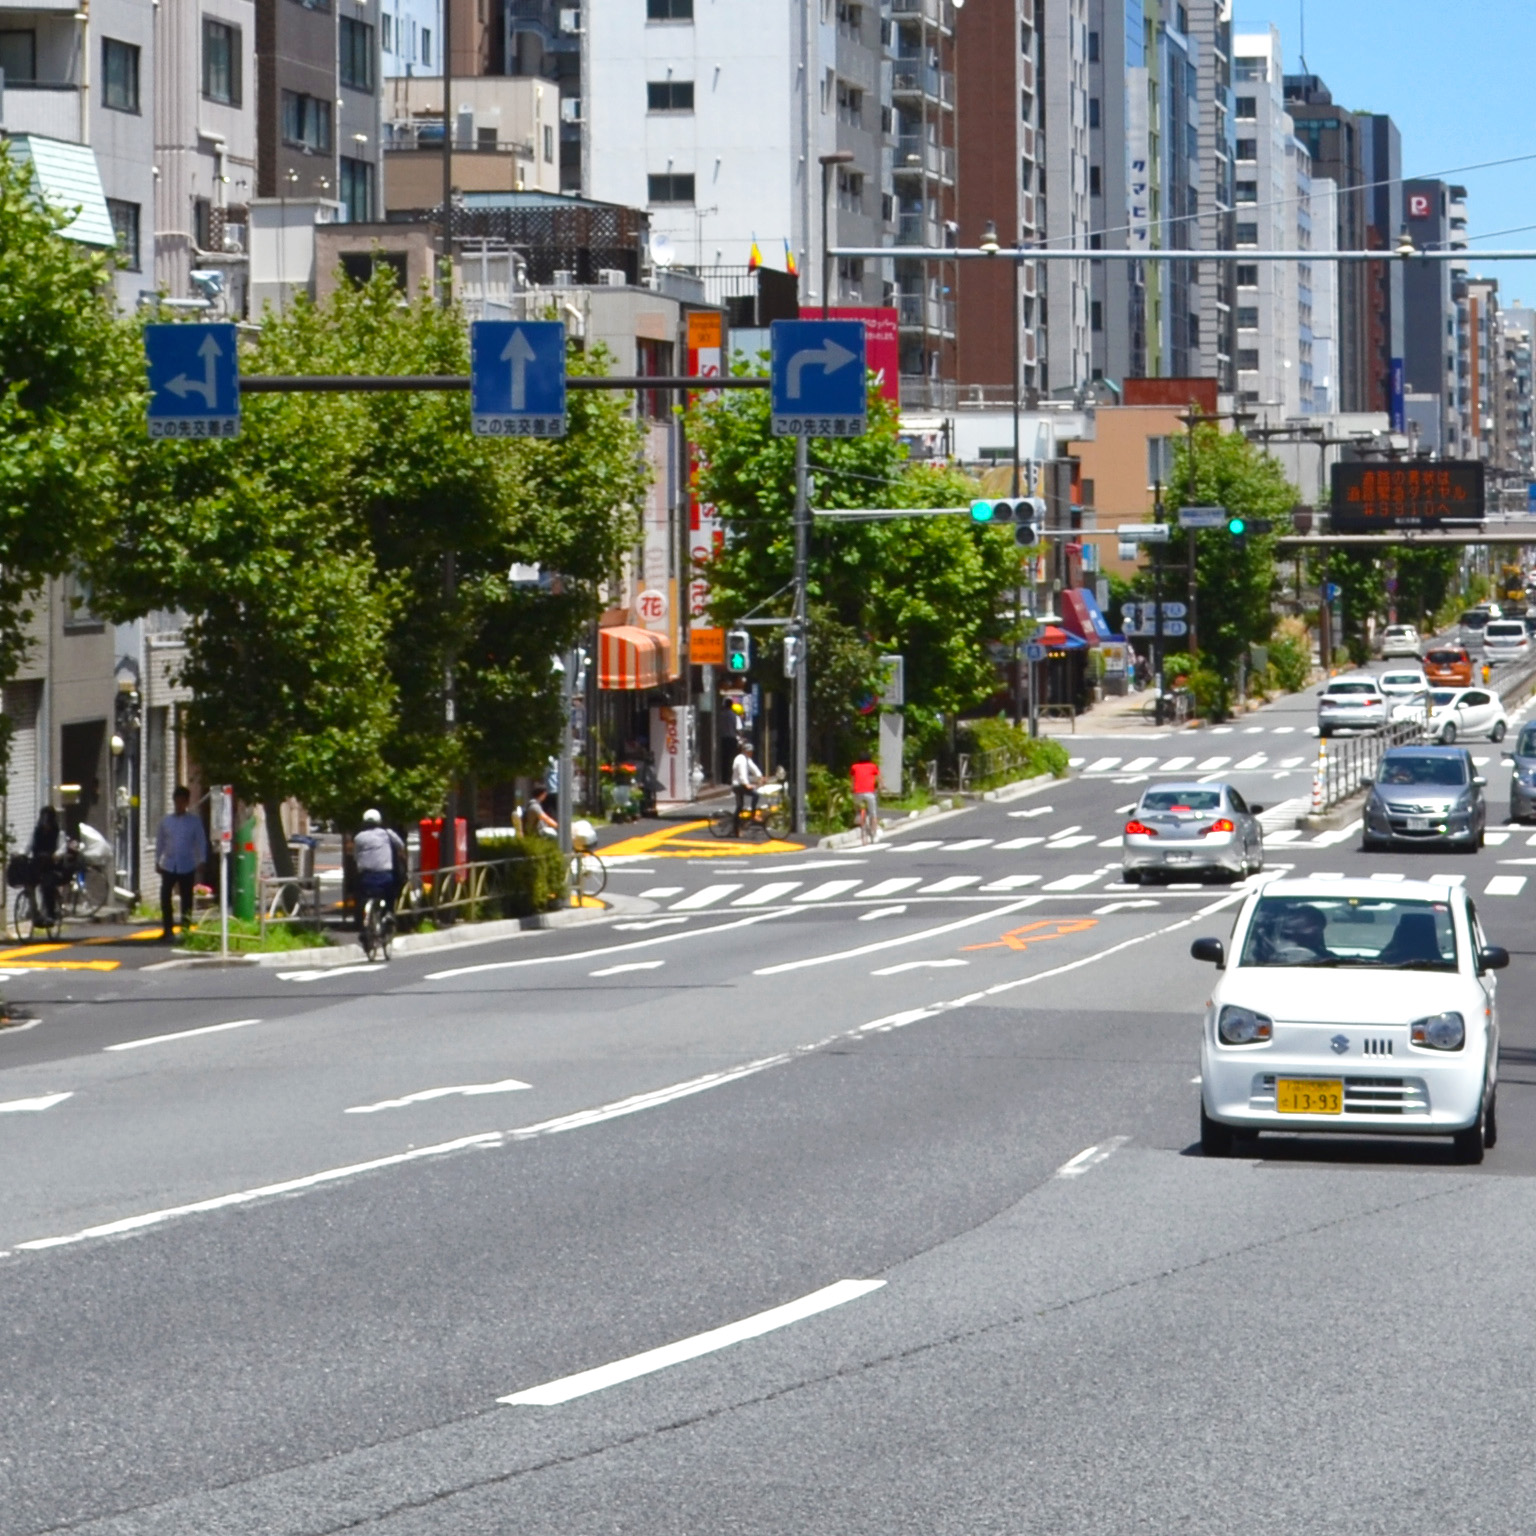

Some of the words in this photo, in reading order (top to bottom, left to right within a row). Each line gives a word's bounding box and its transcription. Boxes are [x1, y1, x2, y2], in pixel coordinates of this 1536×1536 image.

[151, 420, 235, 437] この先交差点
[476, 418, 562, 435] この先交差点
[776, 418, 862, 435] この先交差点
[641, 596, 663, 618] 花
[1293, 1094, 1339, 1111] 13-93
